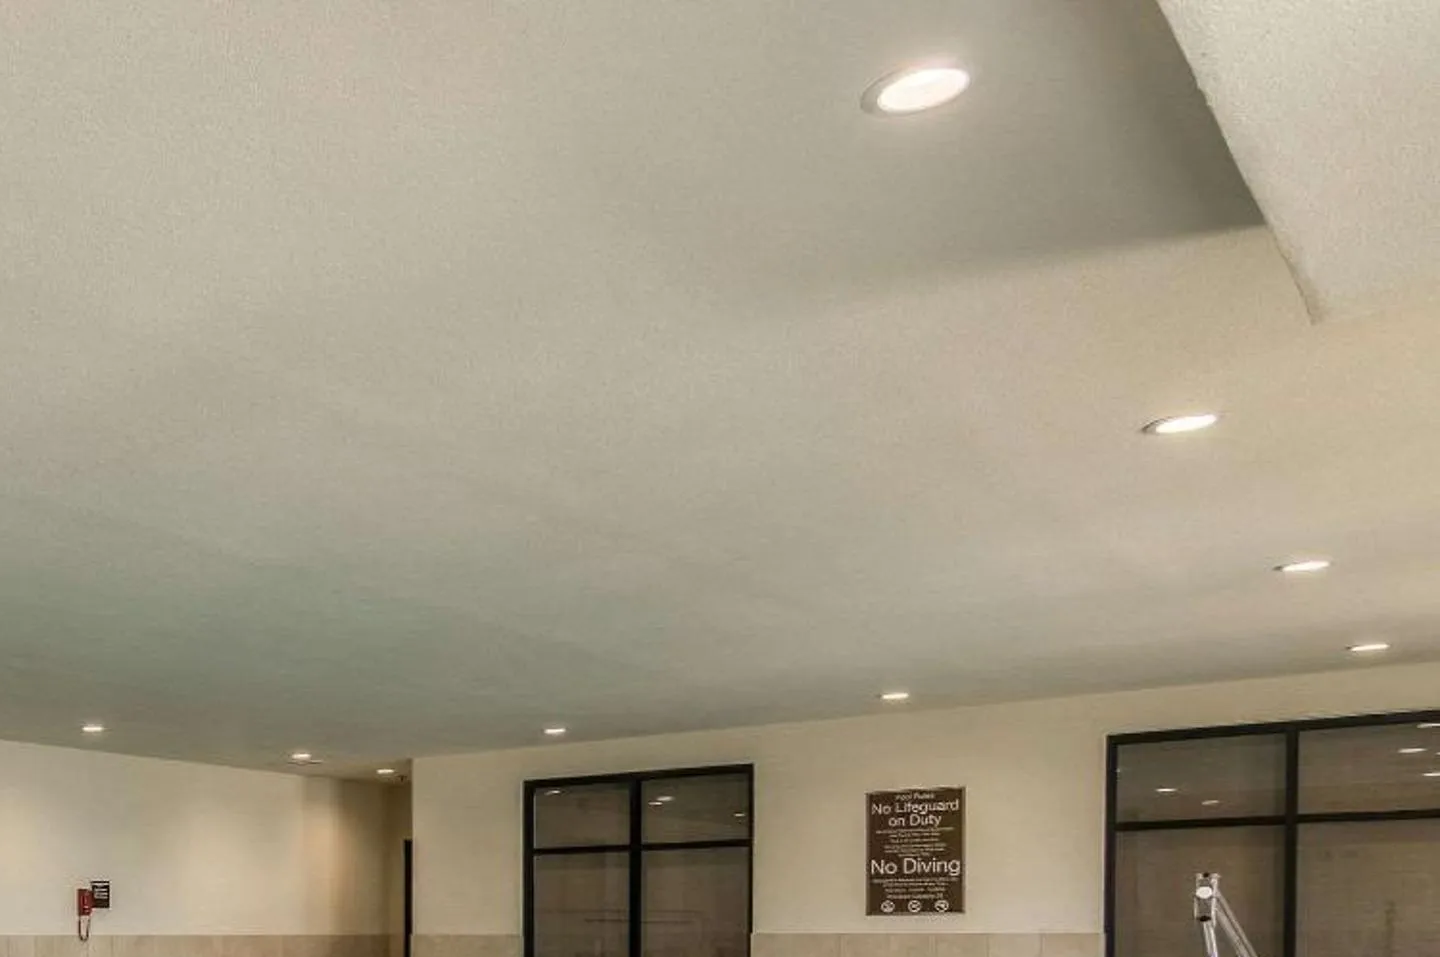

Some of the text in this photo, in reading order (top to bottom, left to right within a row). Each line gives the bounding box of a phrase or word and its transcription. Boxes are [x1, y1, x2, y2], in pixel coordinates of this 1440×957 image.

[871, 799, 960, 815] No Lifeguard
[888, 813, 942, 827] on Duty
[871, 857, 960, 876] No Diving
